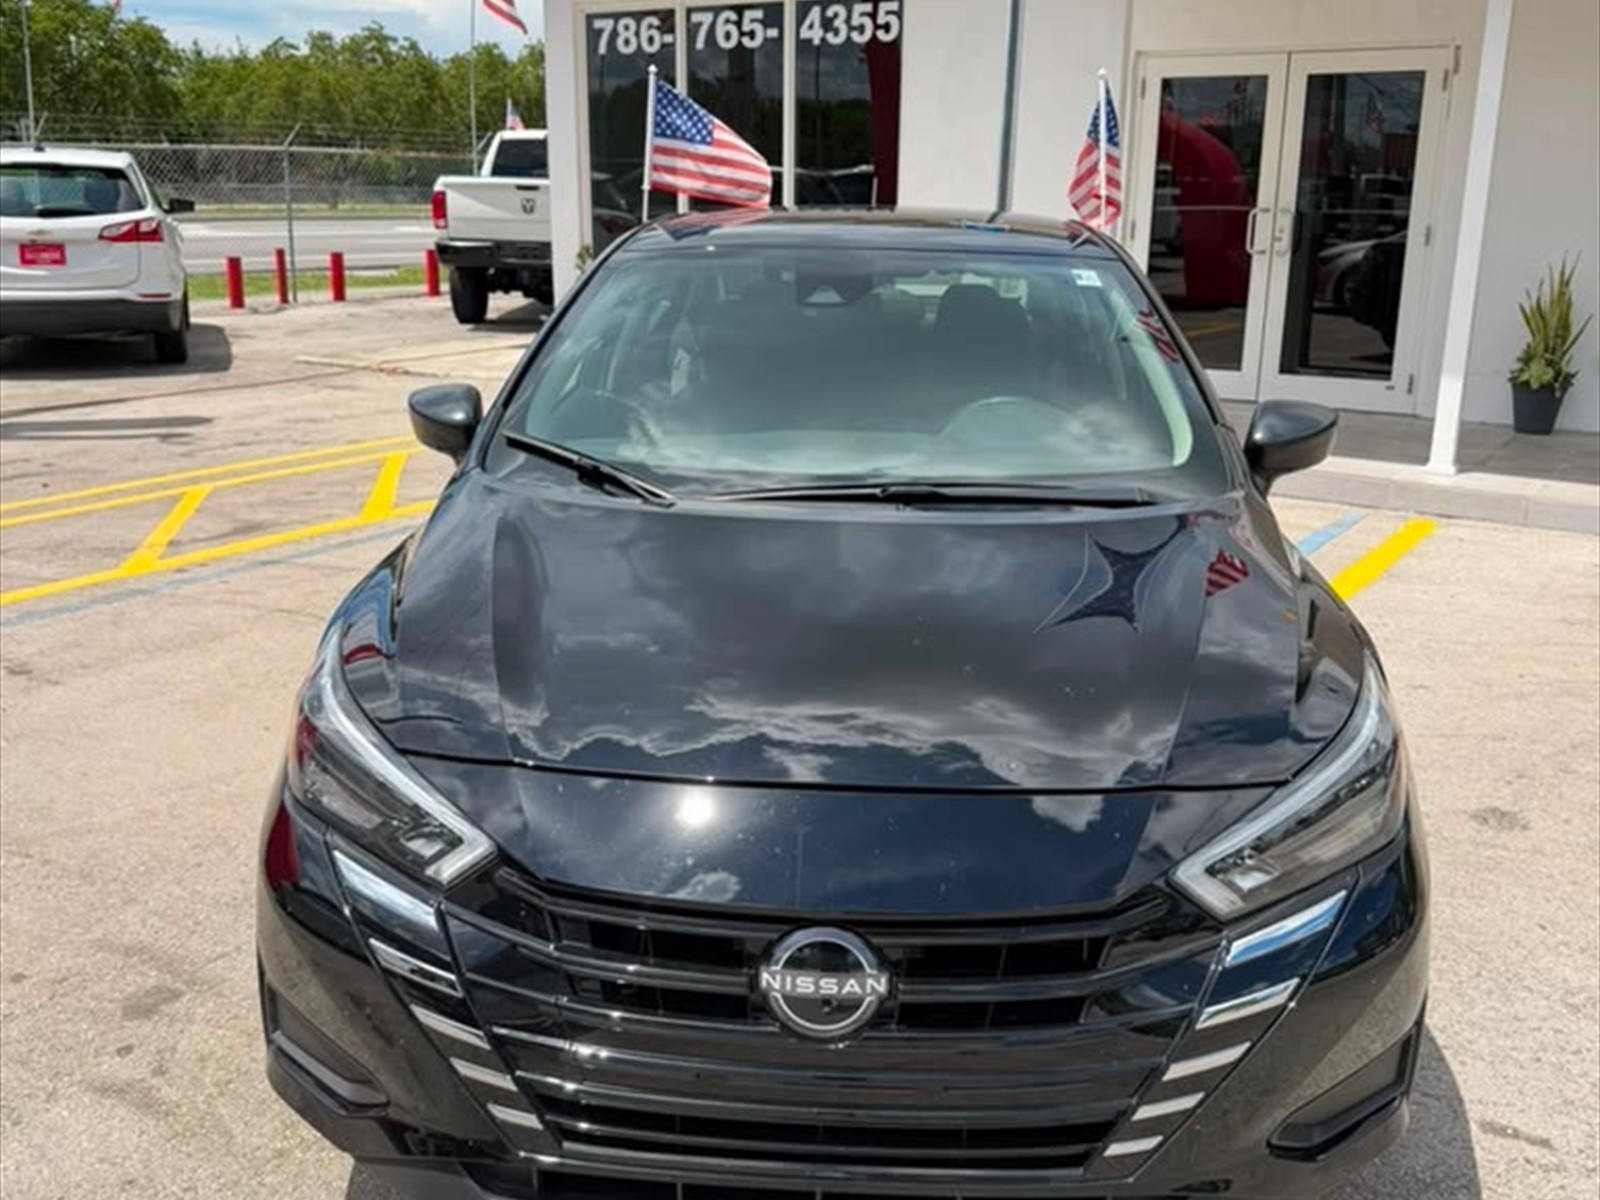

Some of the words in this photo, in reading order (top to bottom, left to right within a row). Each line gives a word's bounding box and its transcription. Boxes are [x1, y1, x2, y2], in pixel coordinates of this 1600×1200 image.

[593, 17, 675, 55] 786-
[691, 9, 779, 51] 765-
[800, 1, 900, 45] 4355
[760, 971, 887, 996] NISSAN
